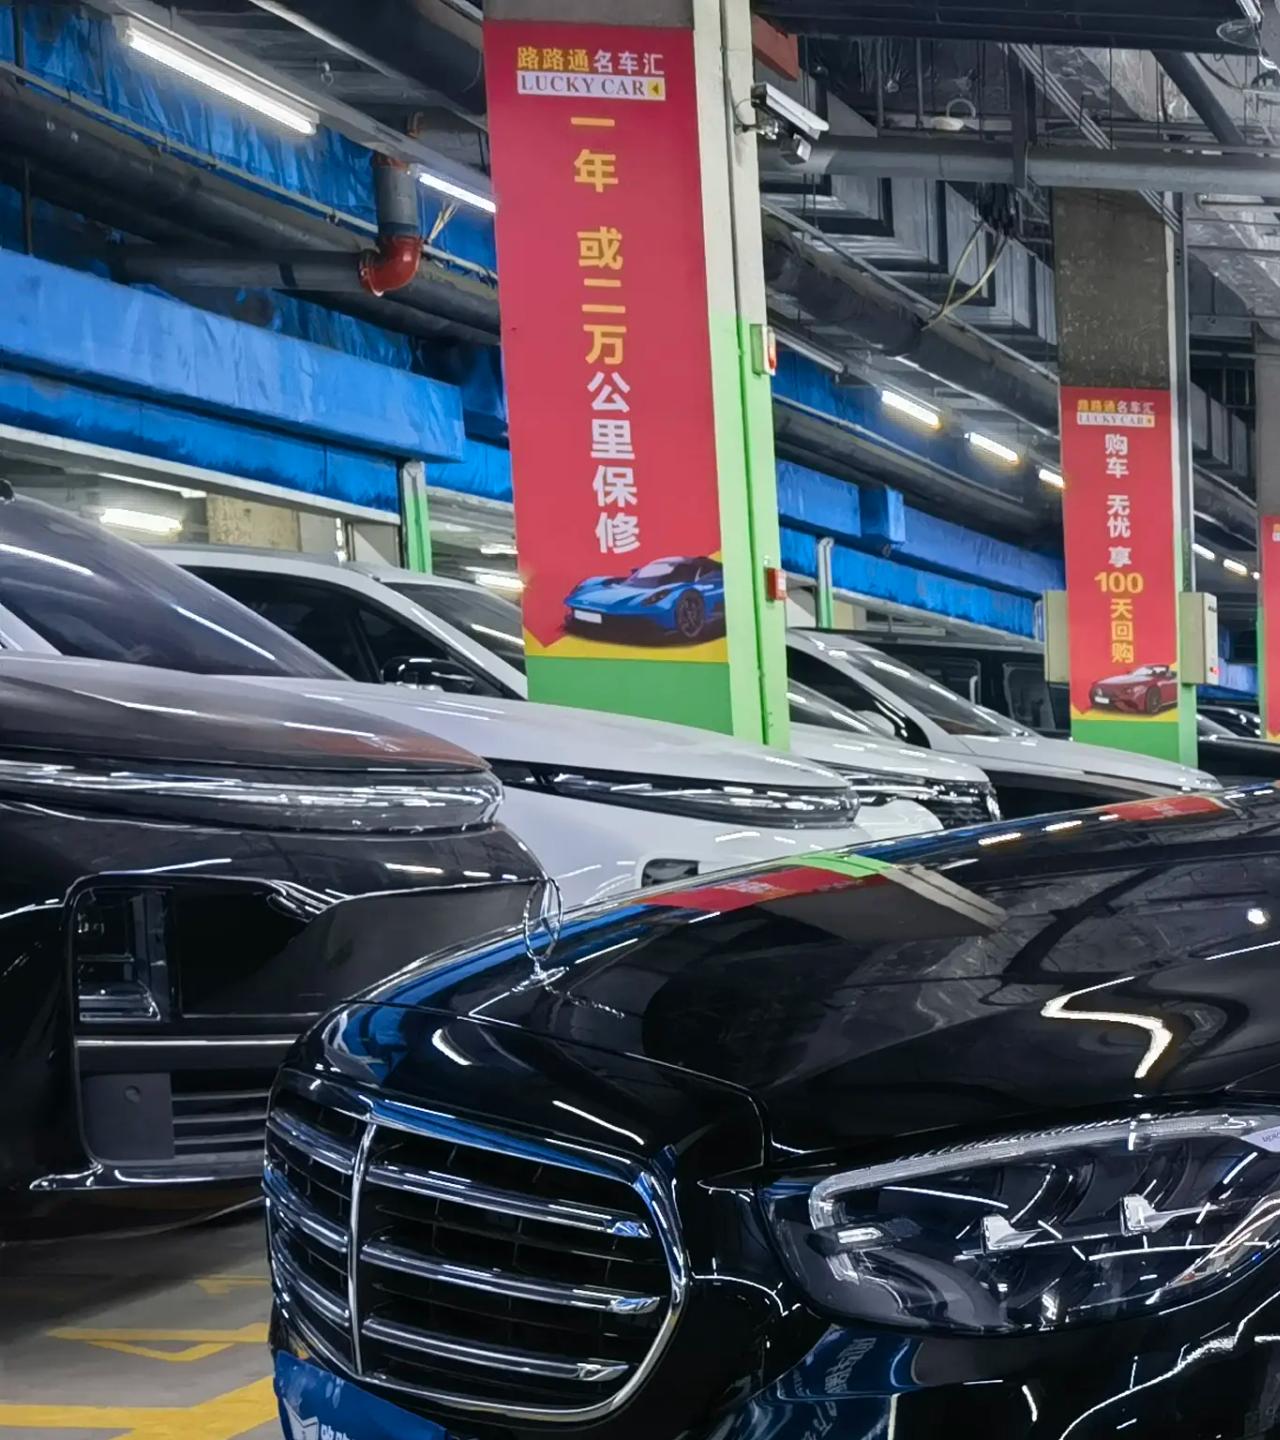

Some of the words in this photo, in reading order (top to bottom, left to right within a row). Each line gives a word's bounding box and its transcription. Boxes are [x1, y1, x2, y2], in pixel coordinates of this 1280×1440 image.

[517, 47, 664, 75] 路路通名车汇
[521, 75, 595, 94] LUCKY
[601, 79, 646, 96] CAR
[570, 117, 619, 192] 一年
[577, 226, 640, 554] 或二万公里保修
[1080, 413, 1117, 424] LUCKY
[1105, 434, 1129, 478] 购车
[1106, 495, 1130, 538] 无忧
